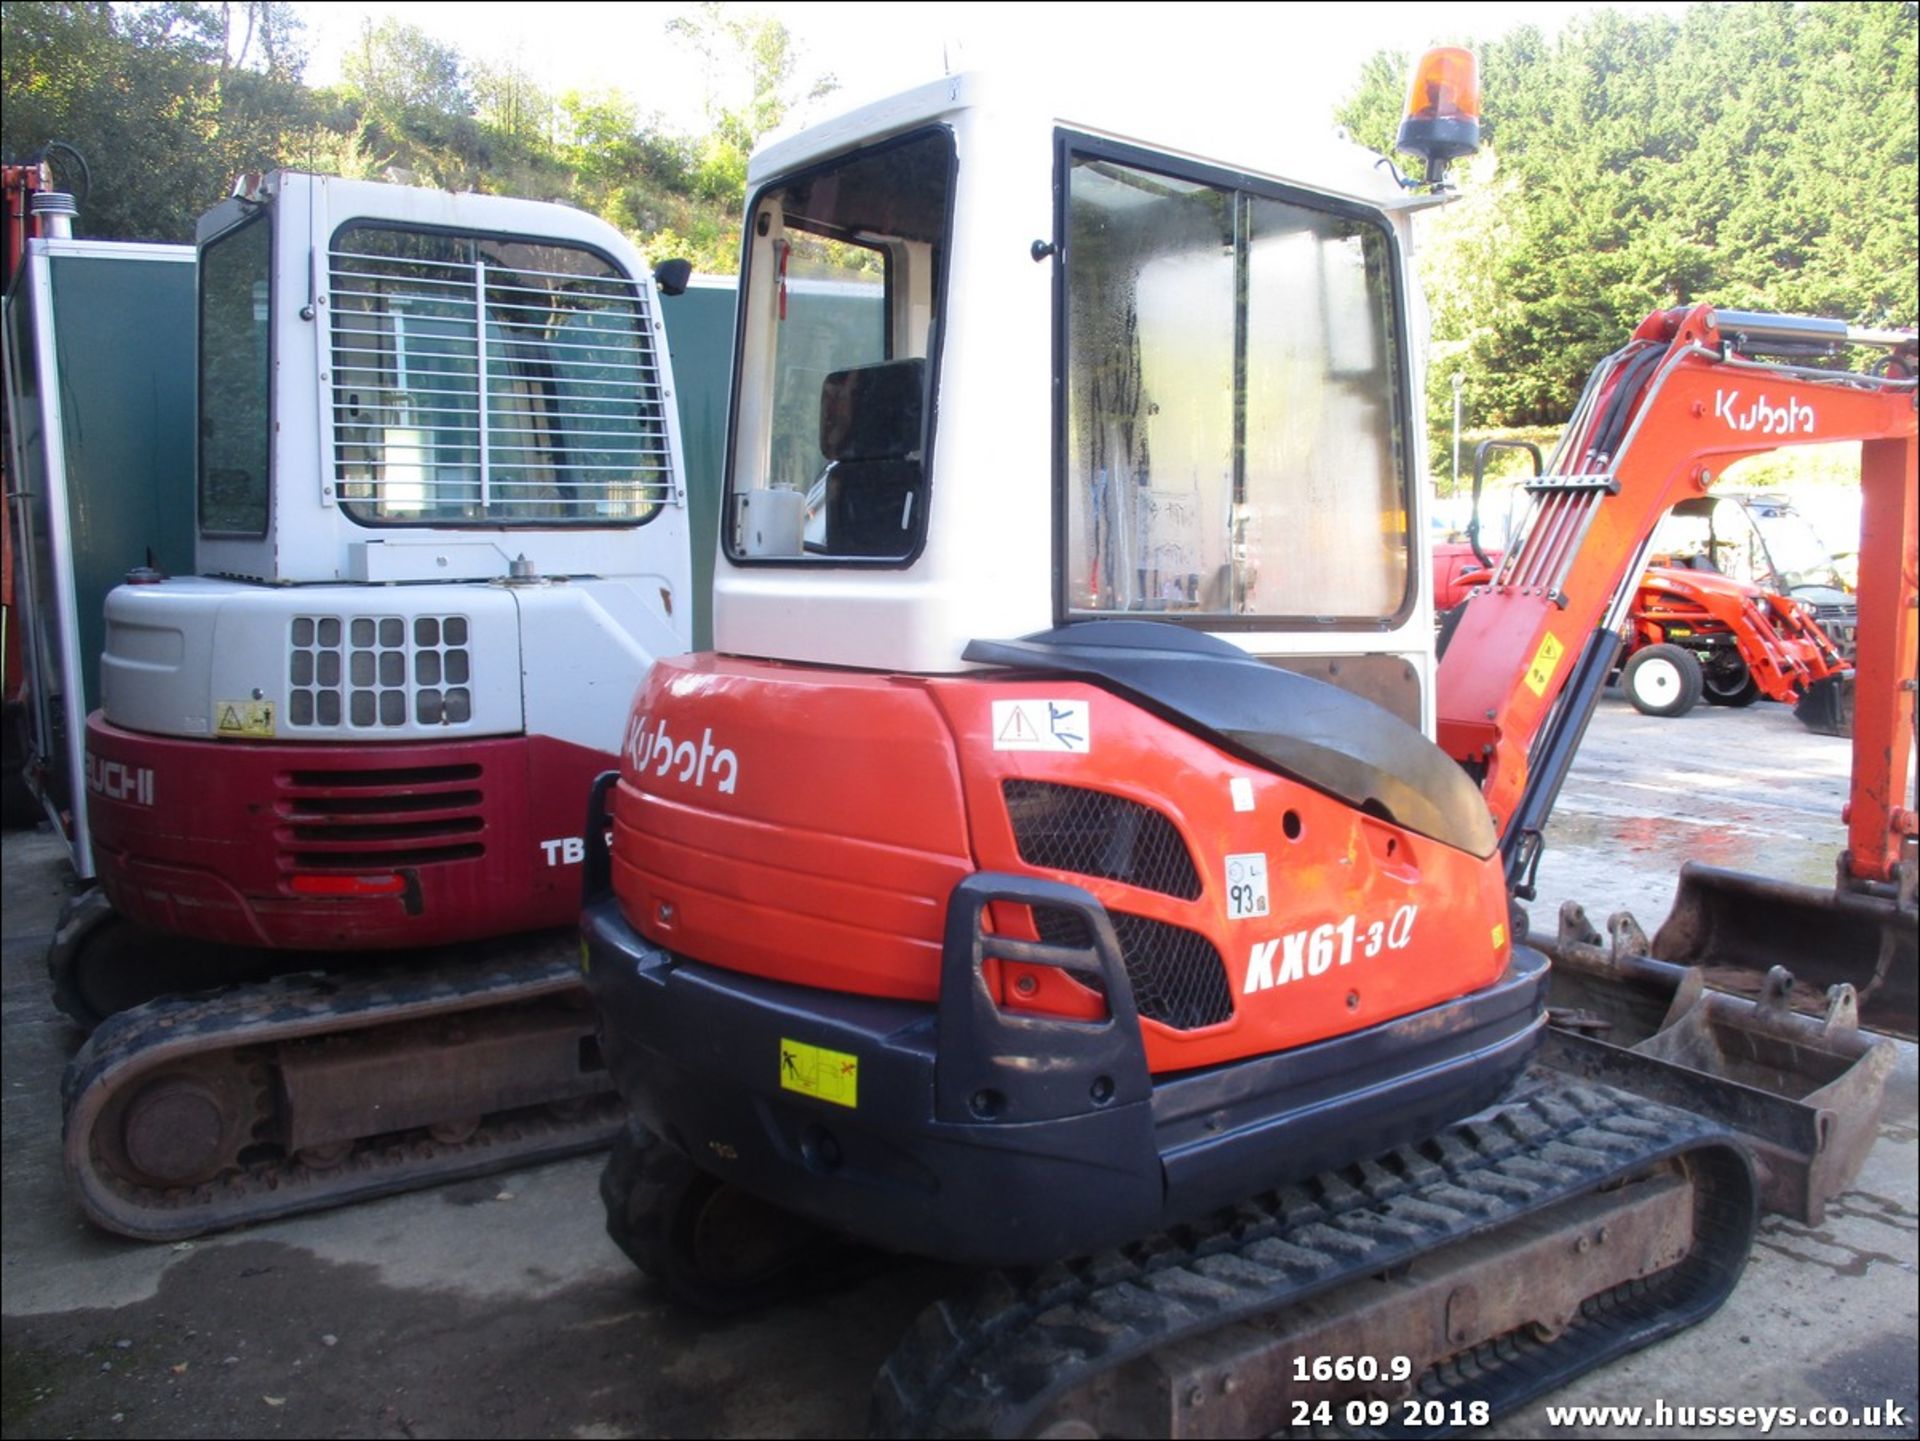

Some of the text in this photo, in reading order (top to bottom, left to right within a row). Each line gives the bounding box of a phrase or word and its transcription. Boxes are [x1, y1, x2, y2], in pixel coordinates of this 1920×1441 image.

[1714, 388, 1815, 435] Kubota
[629, 714, 739, 796] Kubota
[1231, 884, 1254, 914] 93
